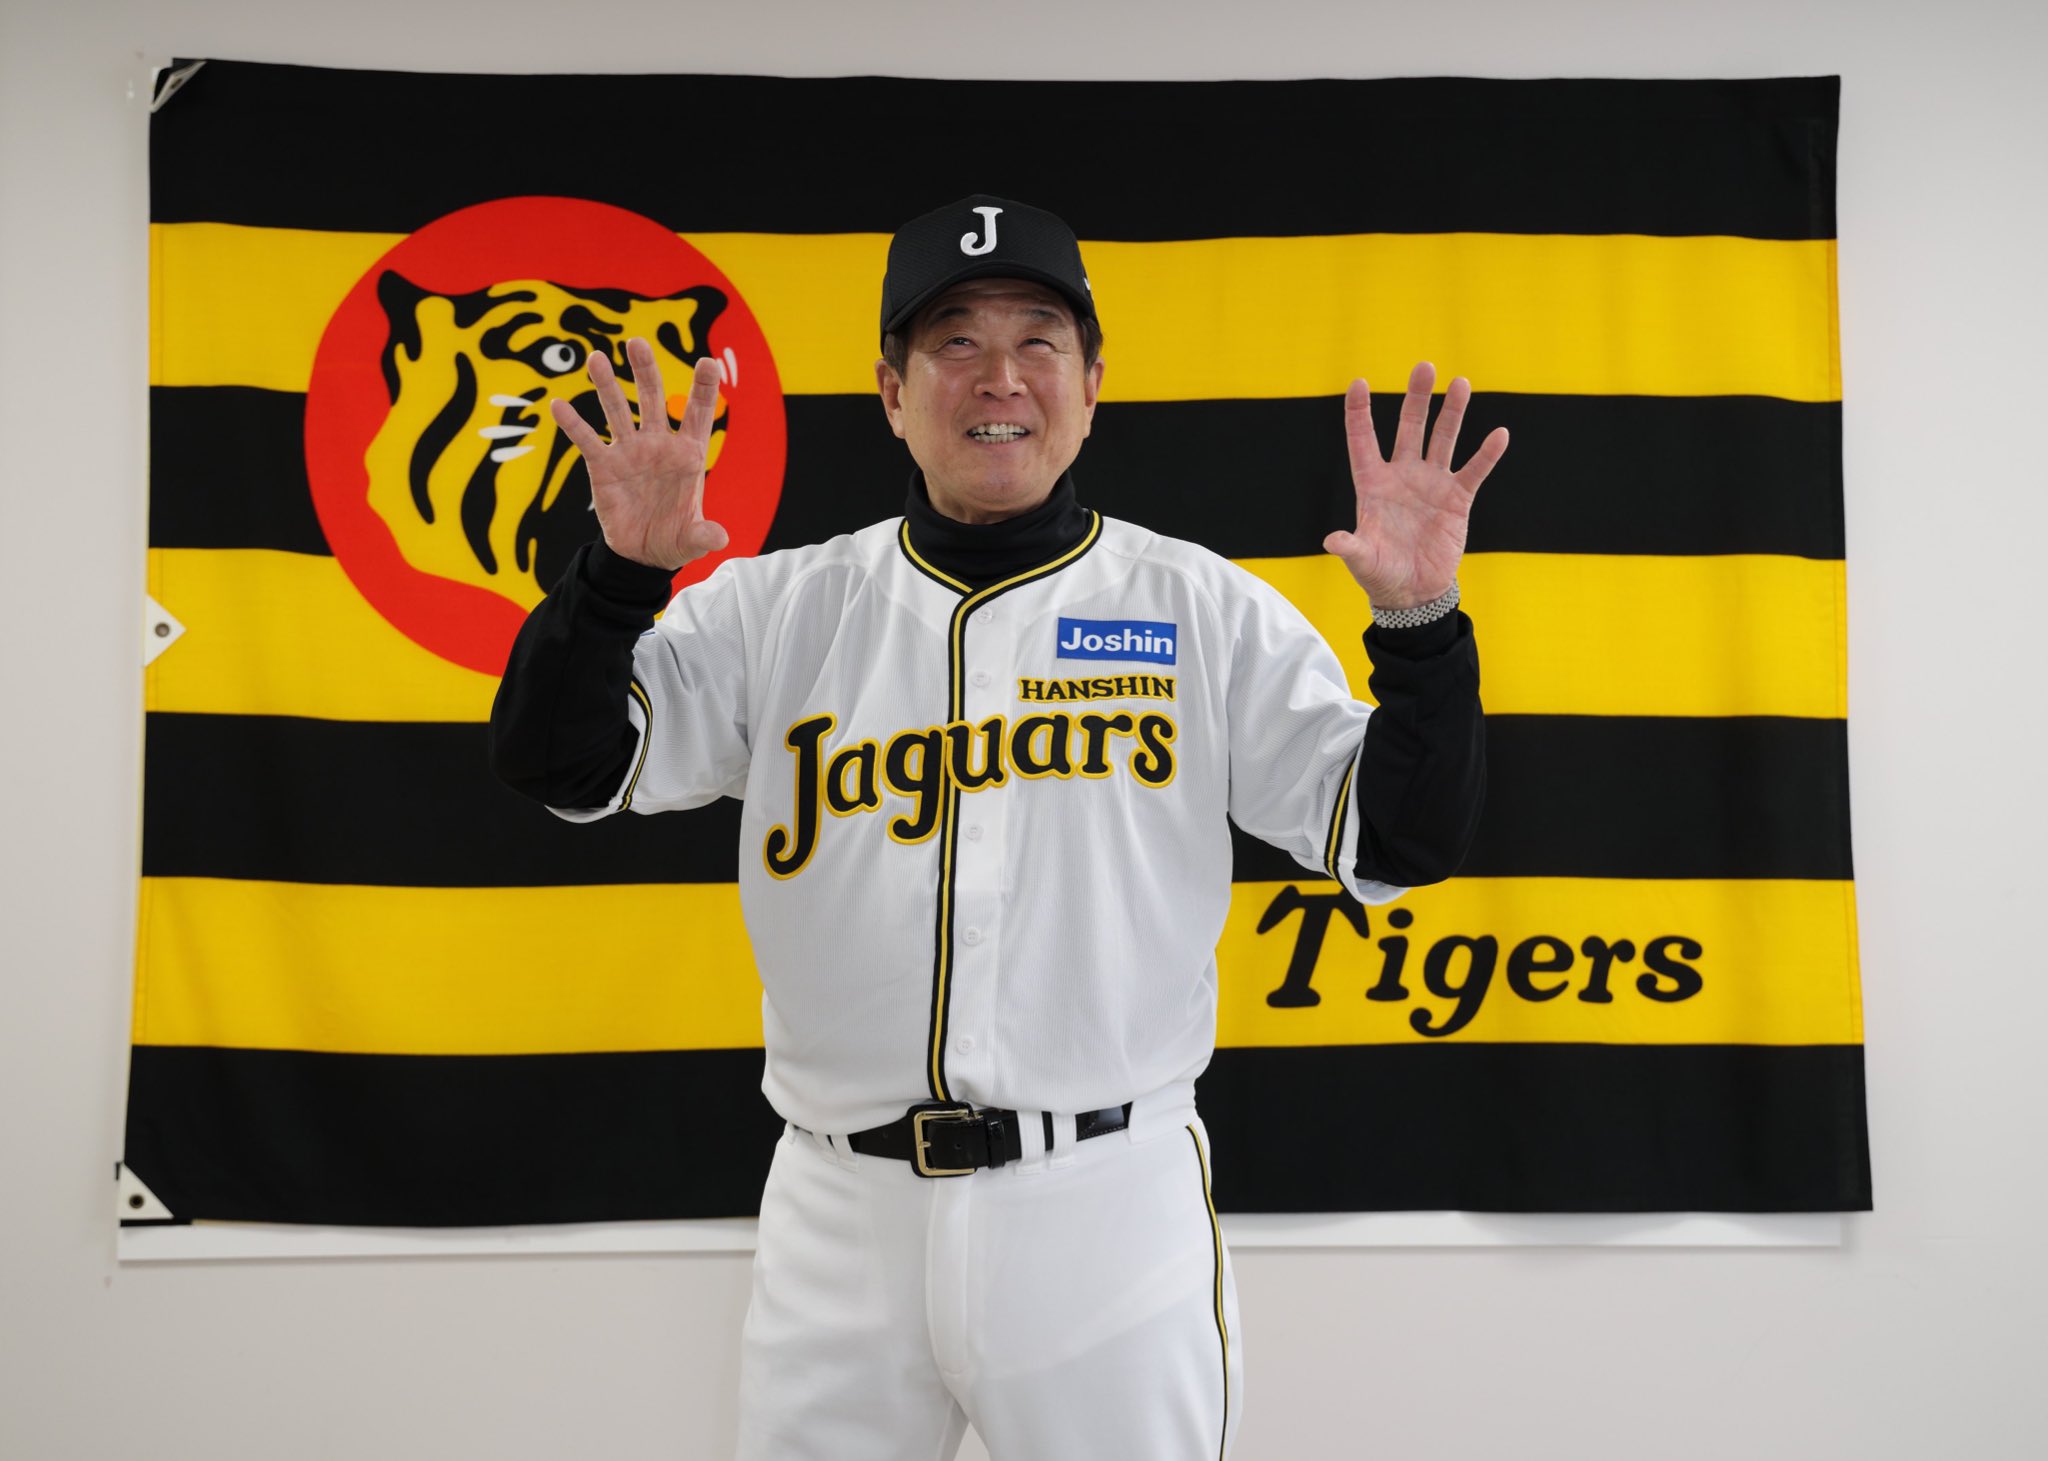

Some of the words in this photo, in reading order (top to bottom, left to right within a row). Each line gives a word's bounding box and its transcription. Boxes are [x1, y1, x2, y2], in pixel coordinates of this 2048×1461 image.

[960, 206, 1003, 256] J
[1061, 627, 1174, 656] Joshin
[1019, 675, 1175, 702] HANSHIN
[763, 711, 1178, 880] Jaguars
[1256, 885, 1703, 1037] Tigers
